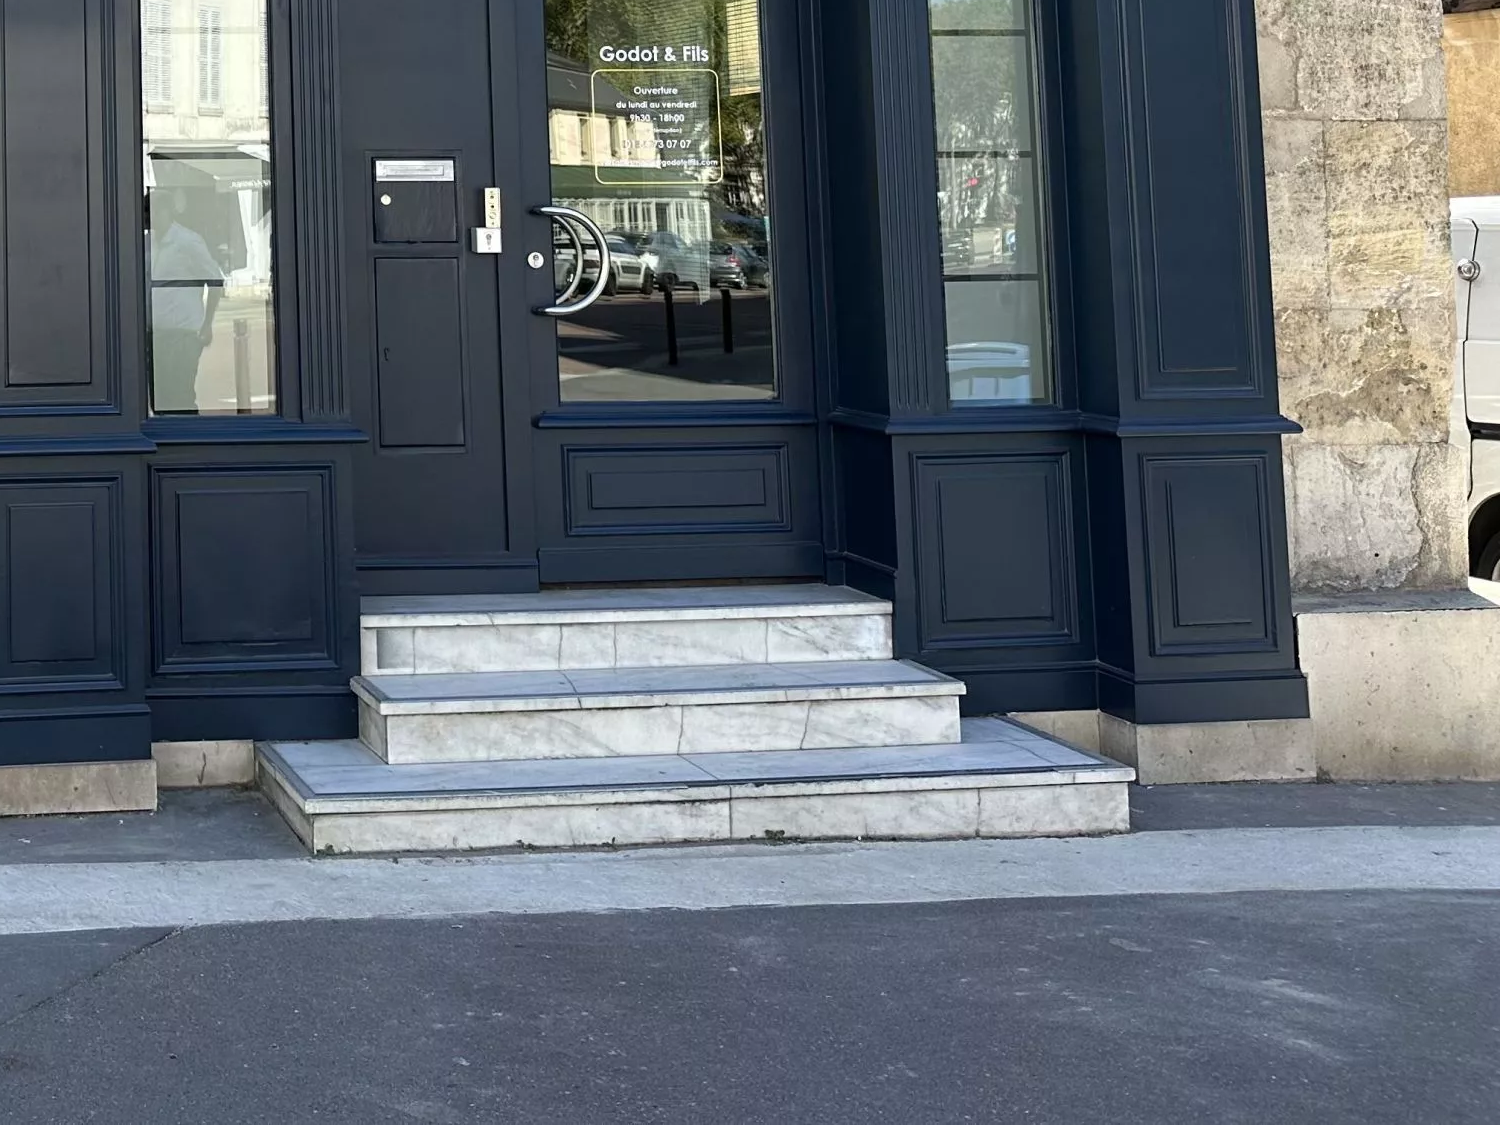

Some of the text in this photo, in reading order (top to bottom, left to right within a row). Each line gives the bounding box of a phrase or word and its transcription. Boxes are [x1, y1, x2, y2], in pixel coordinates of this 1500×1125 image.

[599, 45, 709, 62] Godot & Fils
[633, 86, 678, 95] Ouverture
[616, 101, 627, 109] du
[628, 101, 648, 109] lundi
[662, 101, 697, 109] vendredi
[629, 114, 651, 122] 9h30
[666, 139, 678, 149] 07
[679, 139, 692, 149] 07
